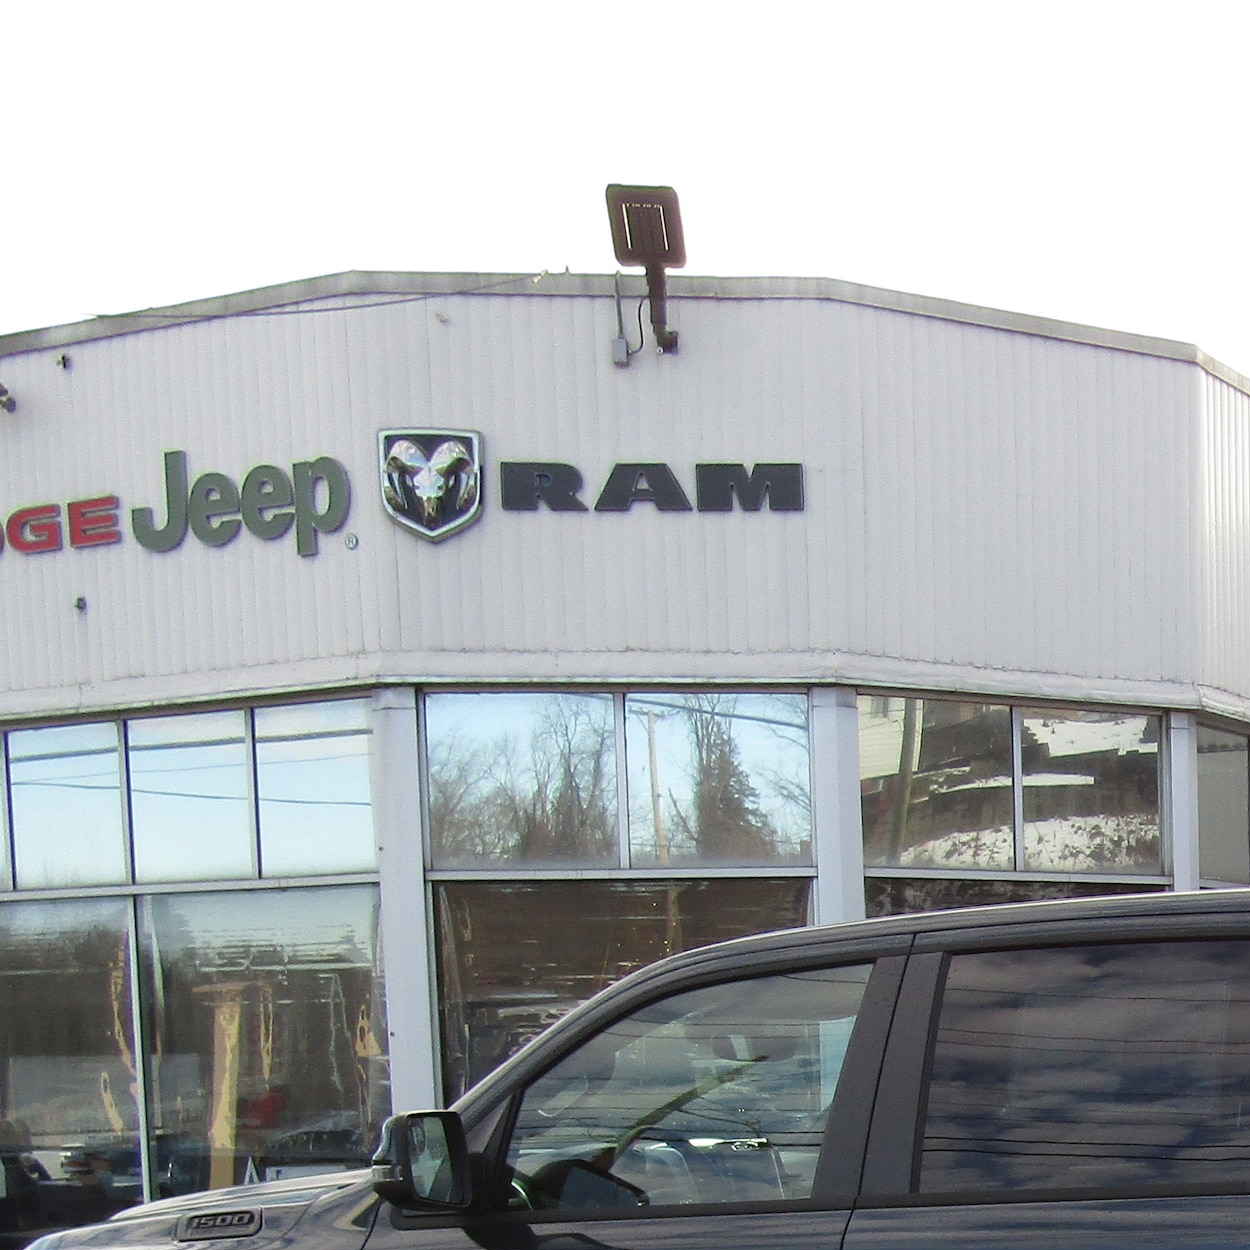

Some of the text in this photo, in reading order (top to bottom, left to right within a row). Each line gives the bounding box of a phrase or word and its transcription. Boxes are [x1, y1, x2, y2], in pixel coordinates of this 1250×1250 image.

[131, 450, 351, 558] Jeep
[500, 461, 805, 511] RAM
[0, 495, 123, 556] GE
[191, 1212, 250, 1229] 1500
